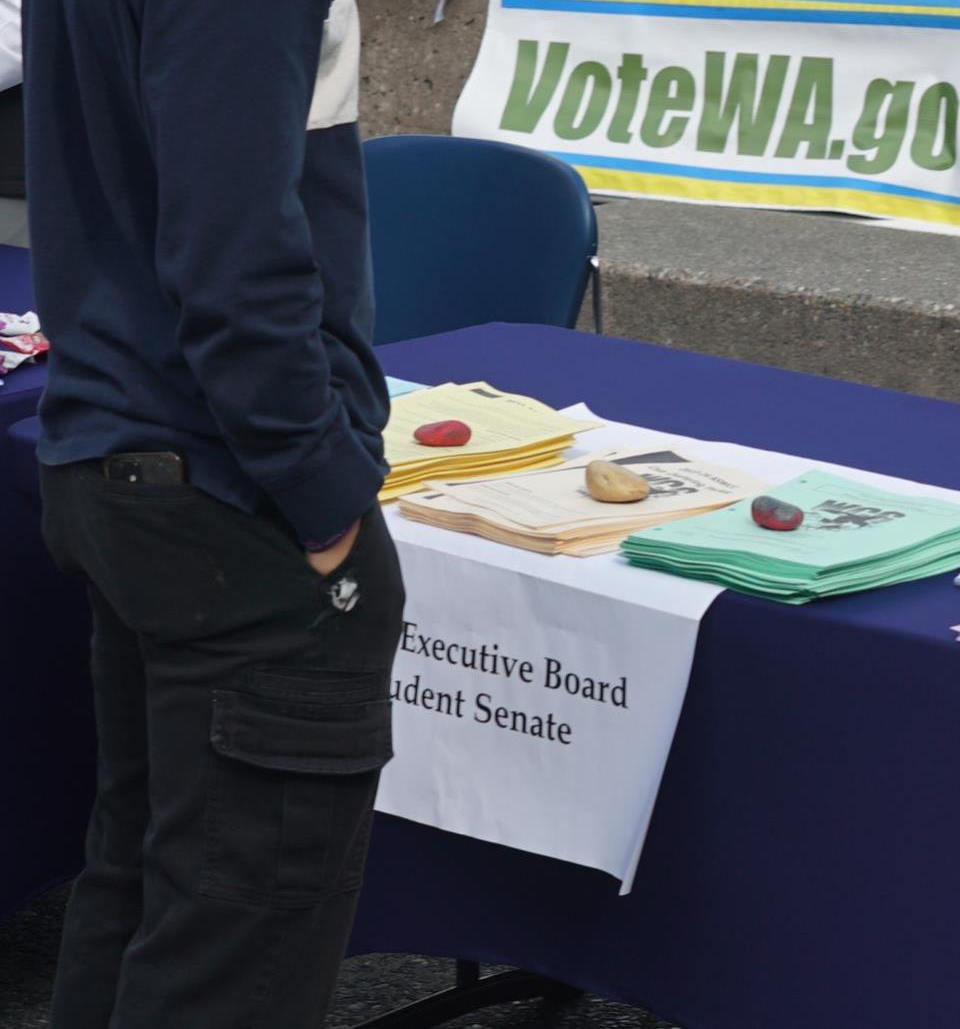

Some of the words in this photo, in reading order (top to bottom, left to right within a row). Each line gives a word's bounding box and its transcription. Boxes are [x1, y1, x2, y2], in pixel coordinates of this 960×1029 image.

[400, 621, 534, 684] Executive
[544, 657, 630, 709] Board
[389, 675, 466, 719] udent
[473, 693, 573, 745] Senate
